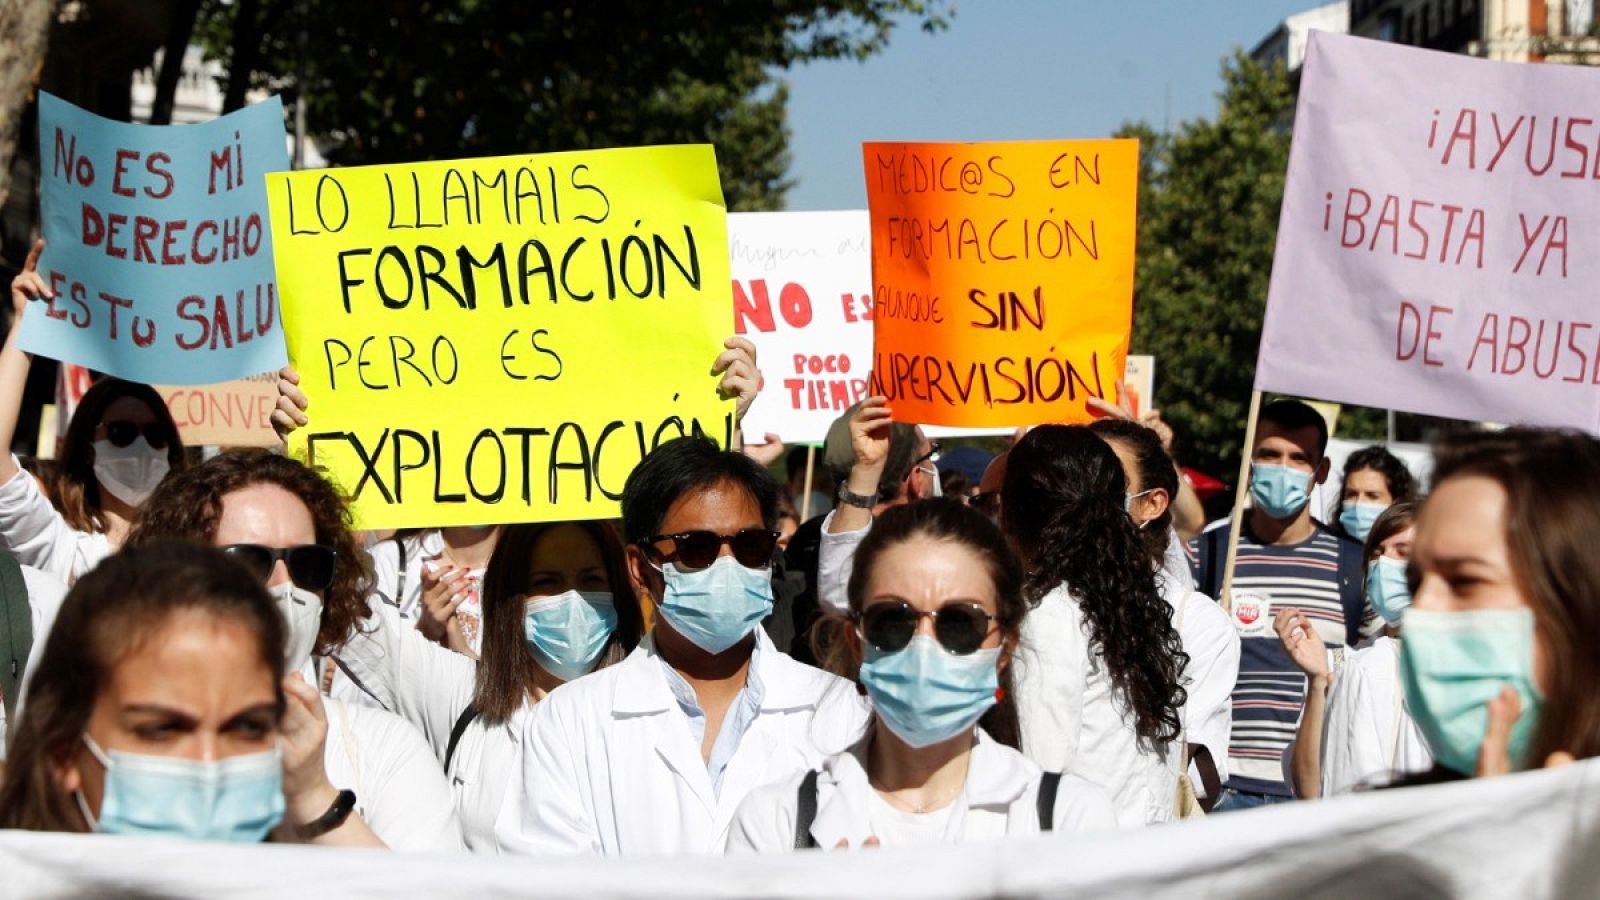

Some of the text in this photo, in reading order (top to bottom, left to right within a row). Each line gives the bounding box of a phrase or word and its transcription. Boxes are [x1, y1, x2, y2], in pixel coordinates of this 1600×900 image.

[112, 149, 174, 199] ES
[877, 146, 1100, 197] MÉDIC@S EN
[1428, 108, 1600, 180] ¡AYUS
[286, 159, 611, 235] LO LLAMÁIS
[81, 202, 262, 265] DERECHO
[887, 208, 1098, 263] FORMACIÓN
[1323, 188, 1568, 278] ¡BASTA YA
[337, 219, 701, 314] FORMACIÓN
[46, 270, 92, 328] ES
[732, 279, 874, 334] NO ES
[876, 284, 1044, 331] AUNQUE SIN
[324, 328, 563, 390] PERO ES
[793, 353, 851, 375] POCO
[1395, 301, 1600, 386] DE ABUS
